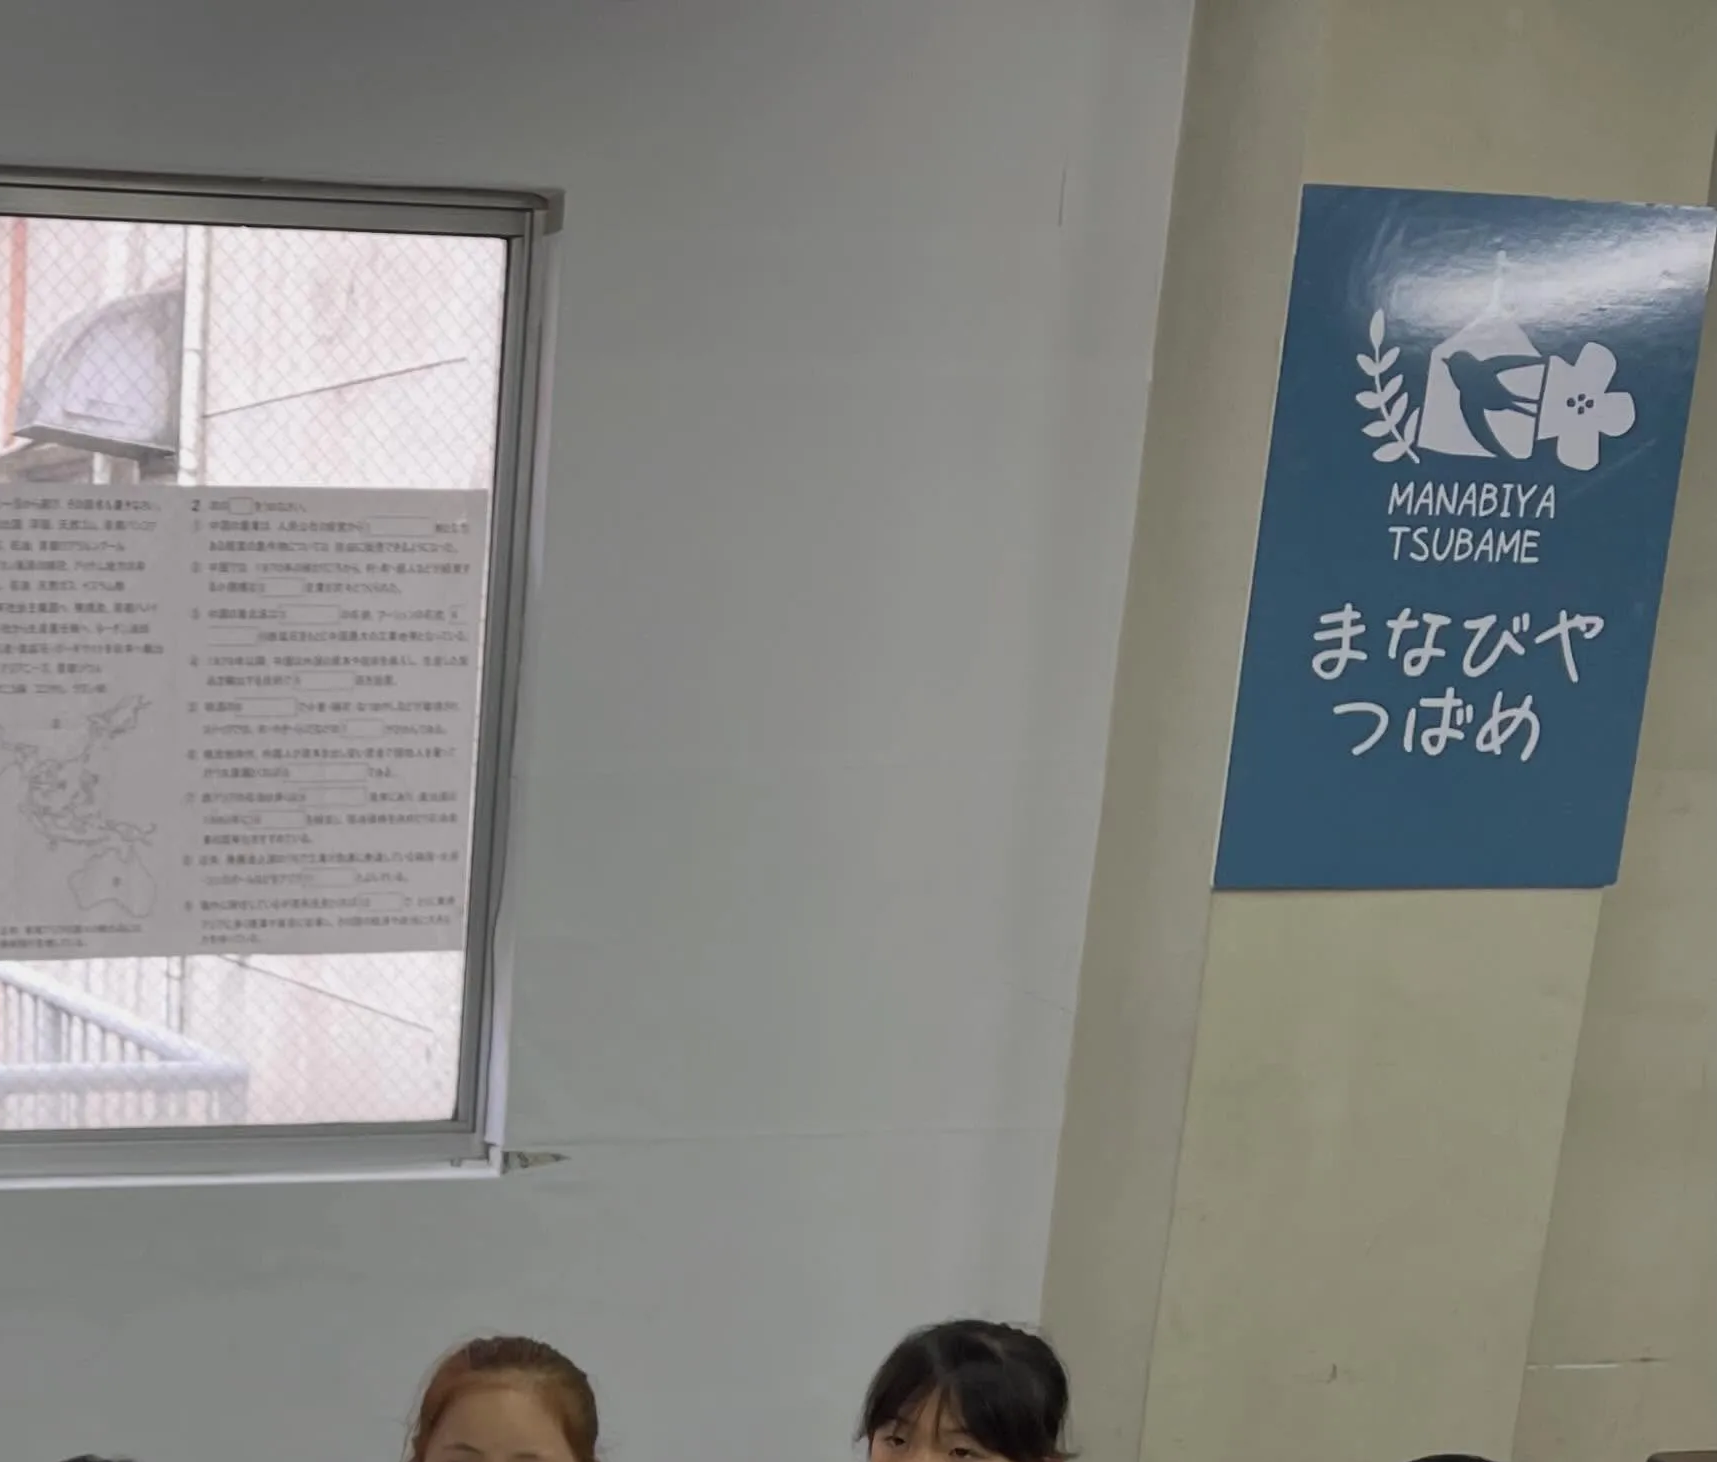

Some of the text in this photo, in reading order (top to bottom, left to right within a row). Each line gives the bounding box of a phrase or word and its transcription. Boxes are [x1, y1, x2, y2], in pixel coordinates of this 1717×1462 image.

[1388, 481, 1556, 519] MANABIYA
[1388, 527, 1541, 564] TSUBAME
[1310, 601, 1606, 683] まなびや
[1333, 686, 1543, 762] つばめ
